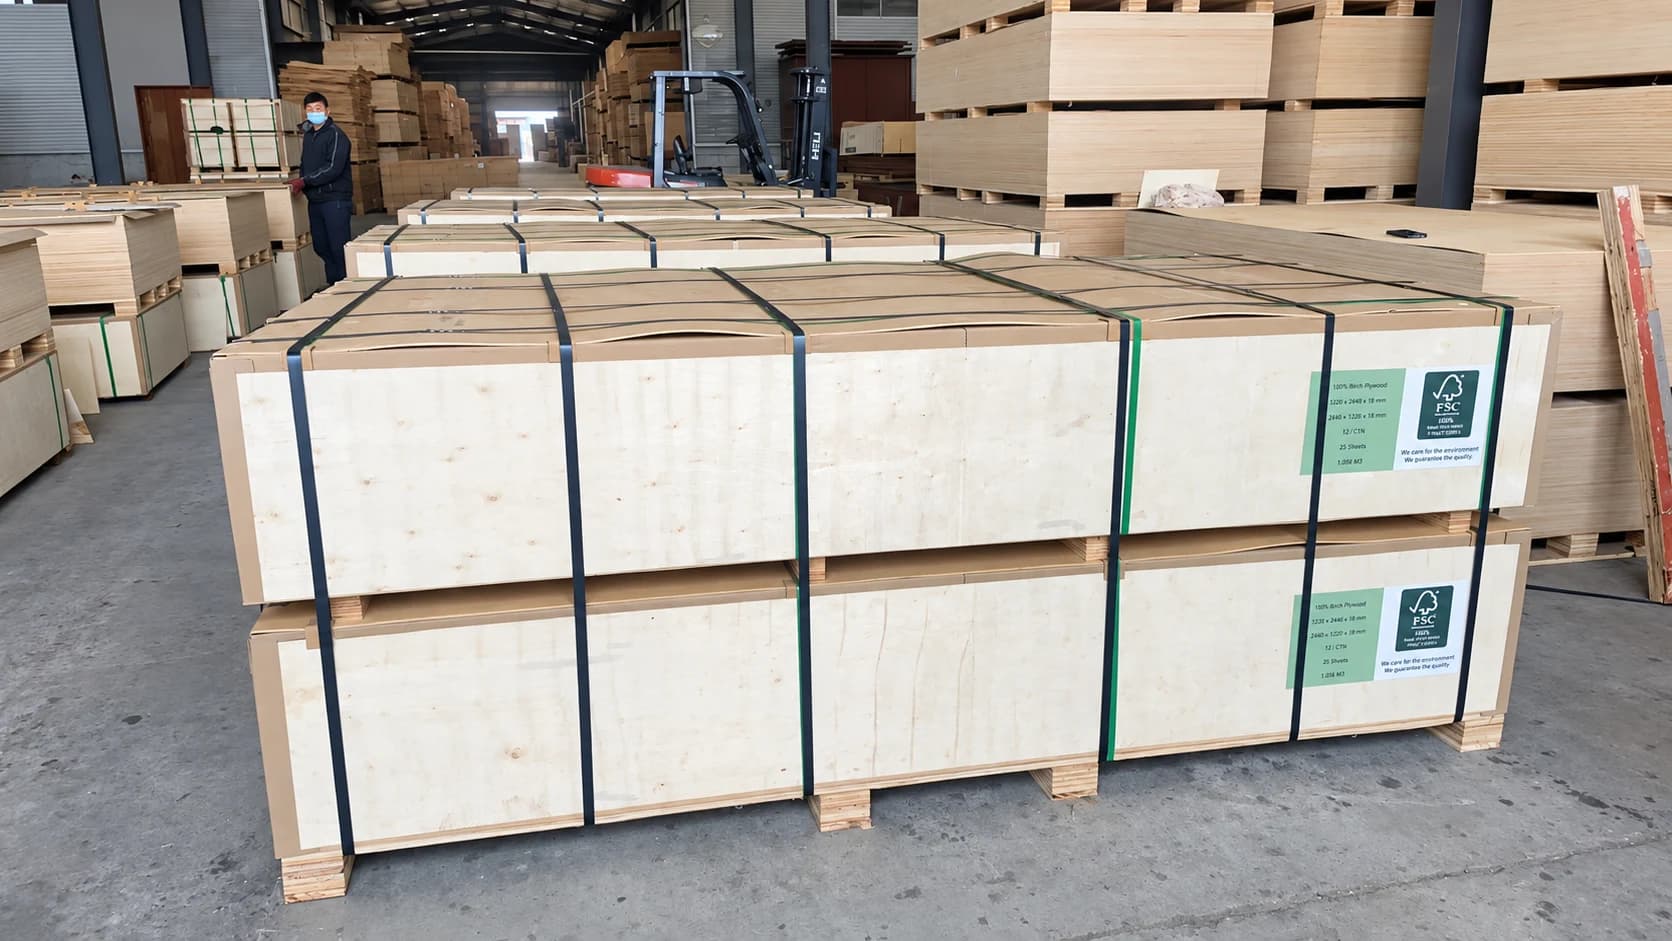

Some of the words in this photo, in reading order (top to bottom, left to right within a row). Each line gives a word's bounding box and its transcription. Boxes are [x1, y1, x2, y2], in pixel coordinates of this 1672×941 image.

[811, 132, 821, 160] HELI
[1364, 382, 1388, 390] Plywood
[1436, 402, 1460, 412] FSC
[1413, 616, 1436, 626] FSC
